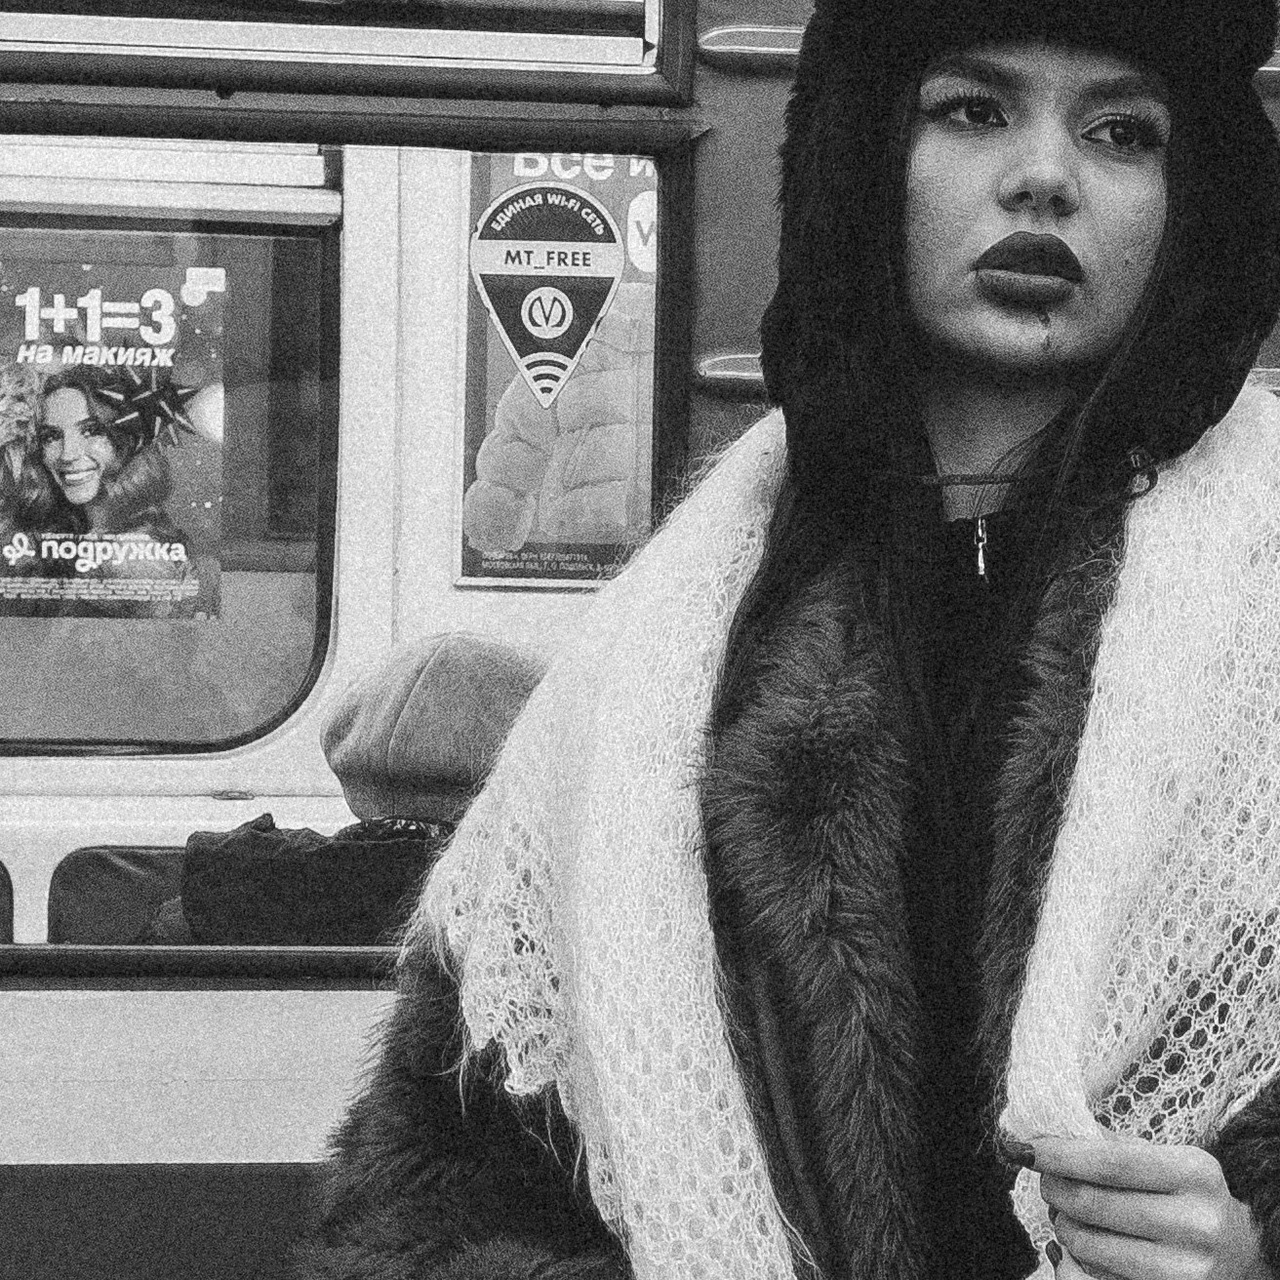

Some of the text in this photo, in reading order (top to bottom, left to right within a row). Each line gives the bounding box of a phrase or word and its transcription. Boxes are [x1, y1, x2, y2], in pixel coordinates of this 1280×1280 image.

[490, 192, 605, 236] ЕДИНАЯ WI-FI СЕТЬ
[504, 249, 592, 270] MT_FREE
[15, 286, 176, 346] 1+1=3
[16, 344, 175, 367] на макияж
[41, 540, 188, 572] подружка
